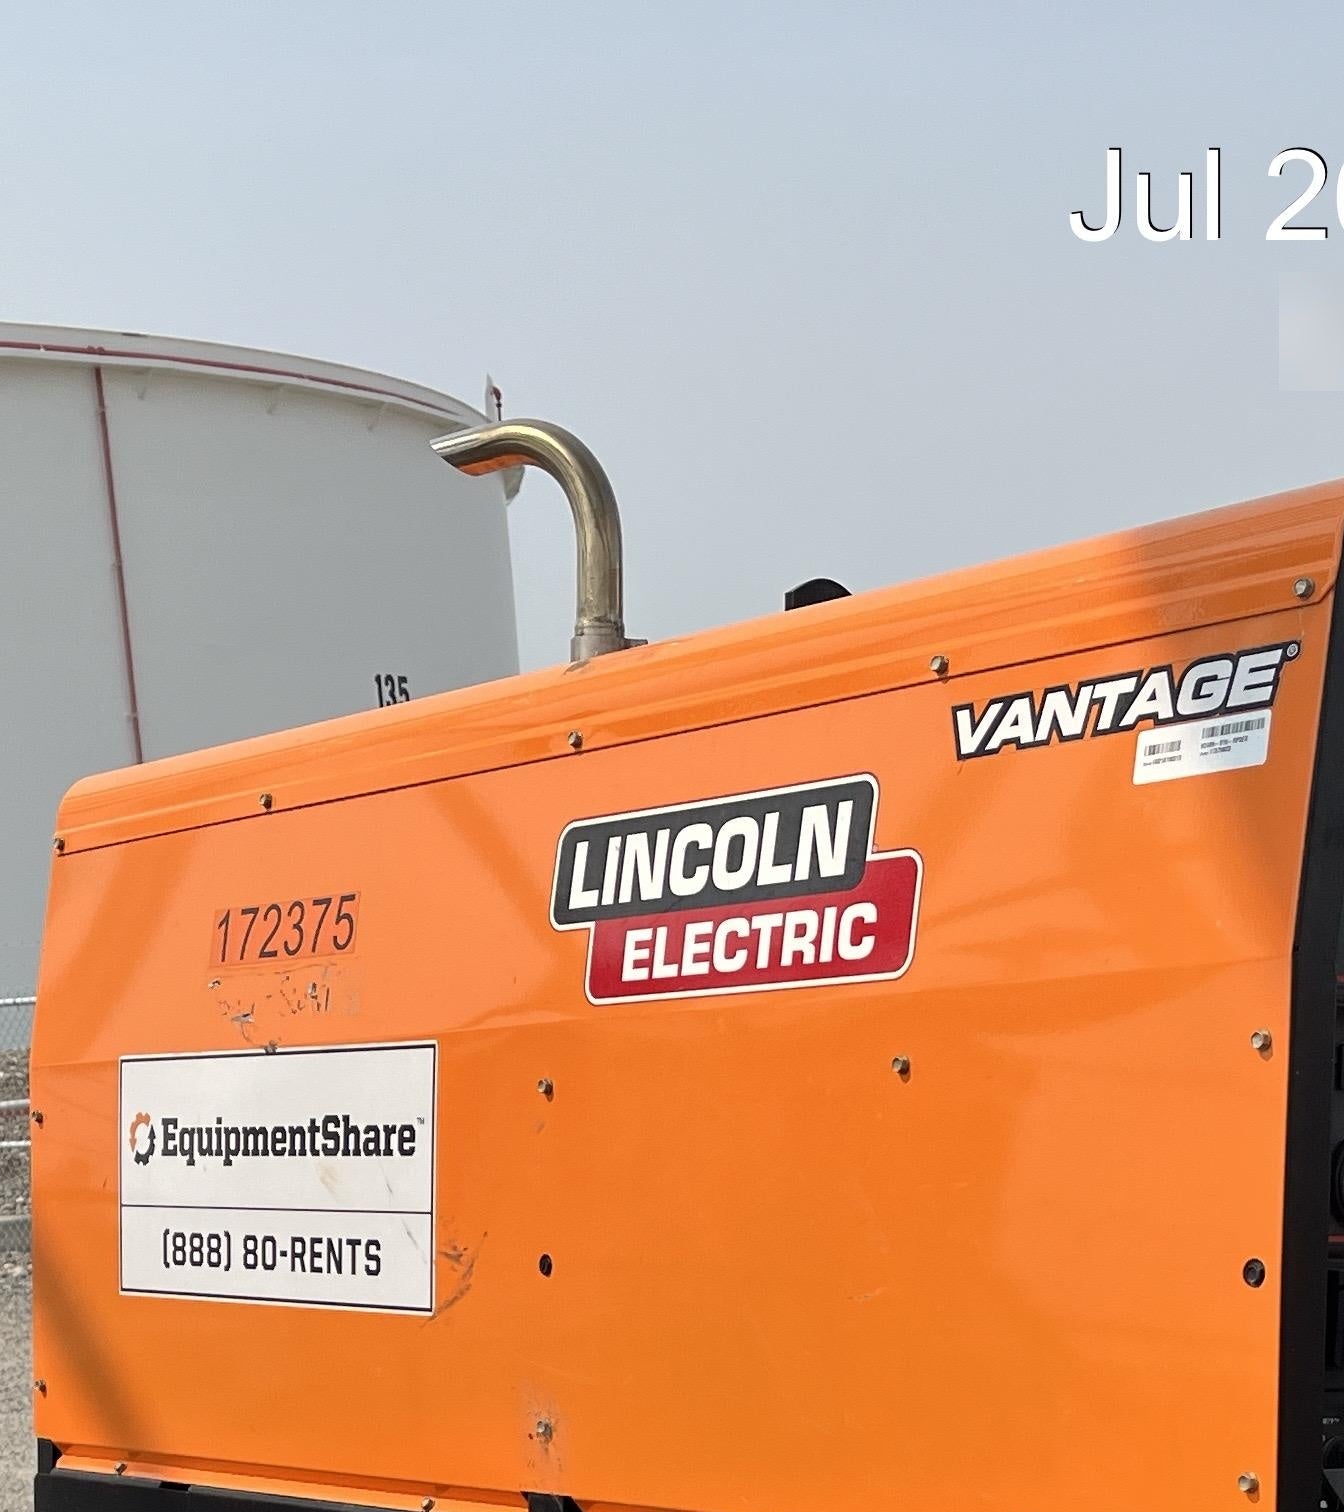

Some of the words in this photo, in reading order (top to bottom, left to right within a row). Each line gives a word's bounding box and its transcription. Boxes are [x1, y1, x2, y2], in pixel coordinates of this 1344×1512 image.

[374, 674, 411, 708] 135
[954, 647, 1286, 756] VANTAGE
[567, 799, 855, 911] LINCOLN
[217, 894, 356, 963] 172375
[620, 901, 878, 983] ELECTRIC
[160, 1114, 417, 1167] EquipmentShare
[162, 1227, 232, 1273] (888)
[242, 1234, 382, 1277] 80-RENTS
